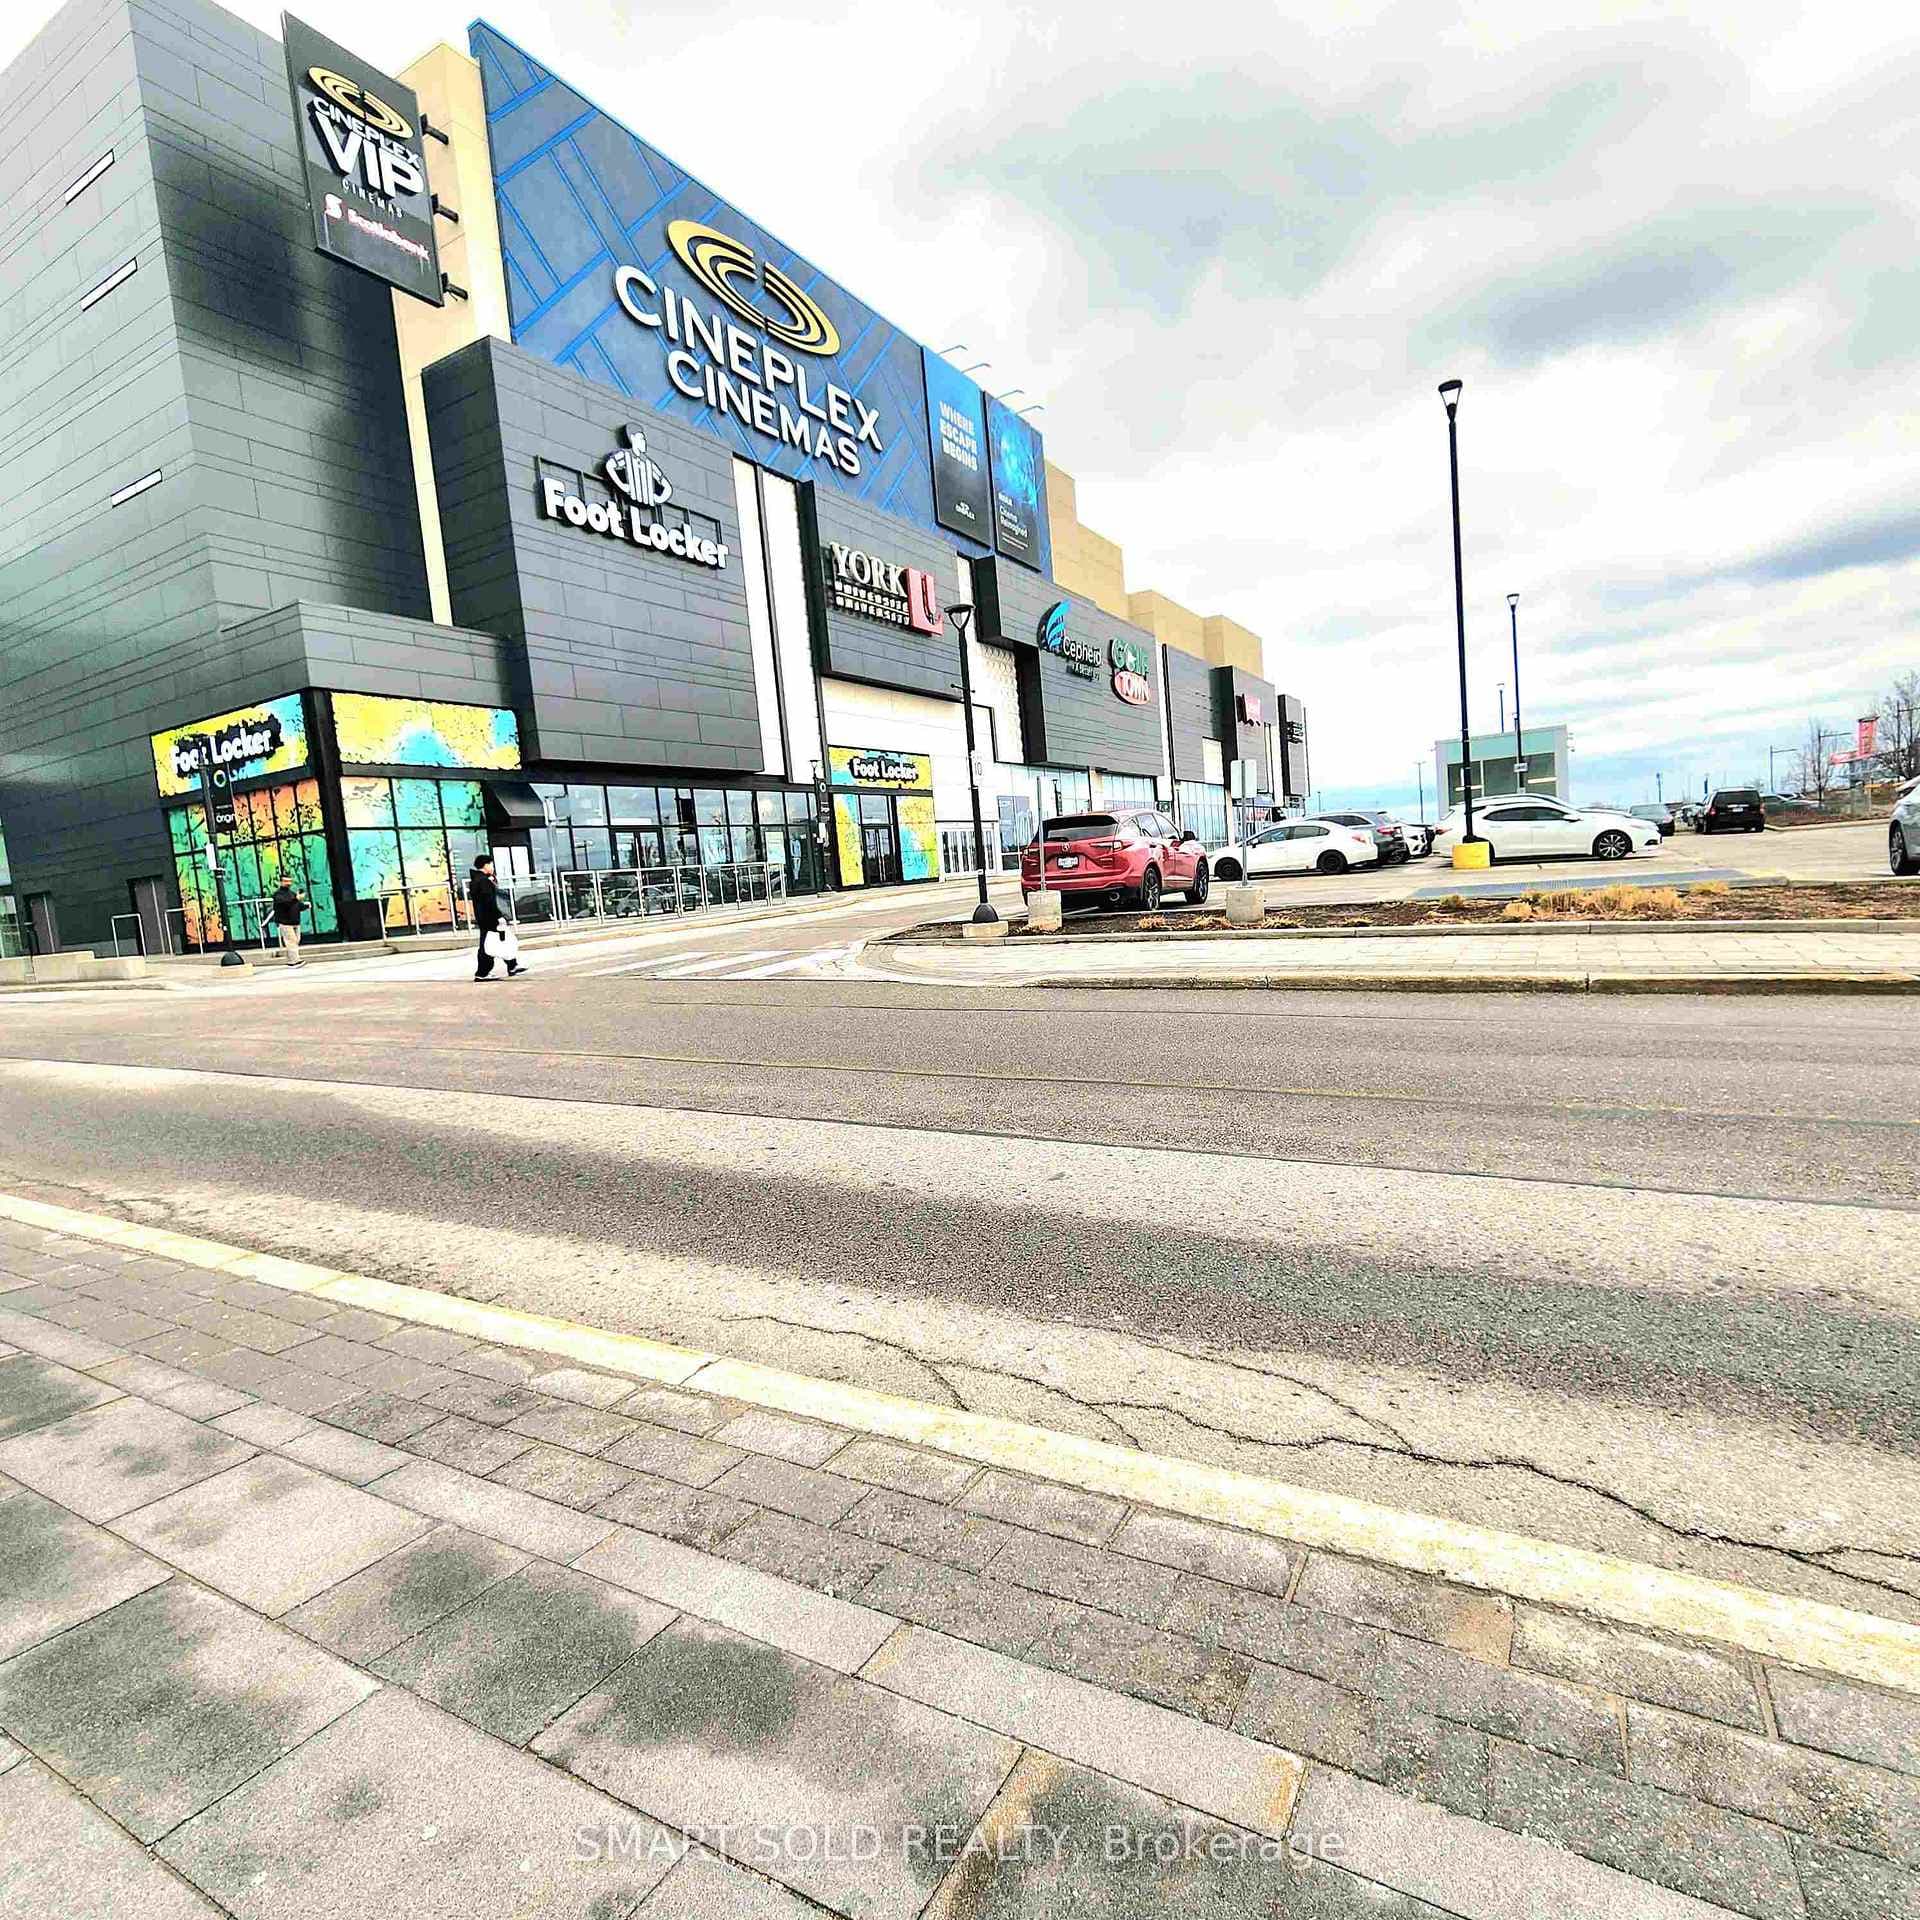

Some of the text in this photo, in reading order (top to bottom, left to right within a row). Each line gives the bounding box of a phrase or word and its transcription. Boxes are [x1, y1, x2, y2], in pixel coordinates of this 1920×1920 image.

[313, 96, 421, 169] CINEPLEX
[315, 110, 424, 199] VIP
[342, 178, 403, 218] CINEMAS
[615, 265, 883, 452] CINEPLEX
[668, 350, 861, 476] CINEMAS
[543, 477, 729, 569] Foot Locker
[830, 541, 908, 598] YORK
[1116, 674, 1150, 701] TOWN
[210, 728, 272, 763] Locker
[853, 758, 917, 780] Foot Locker
